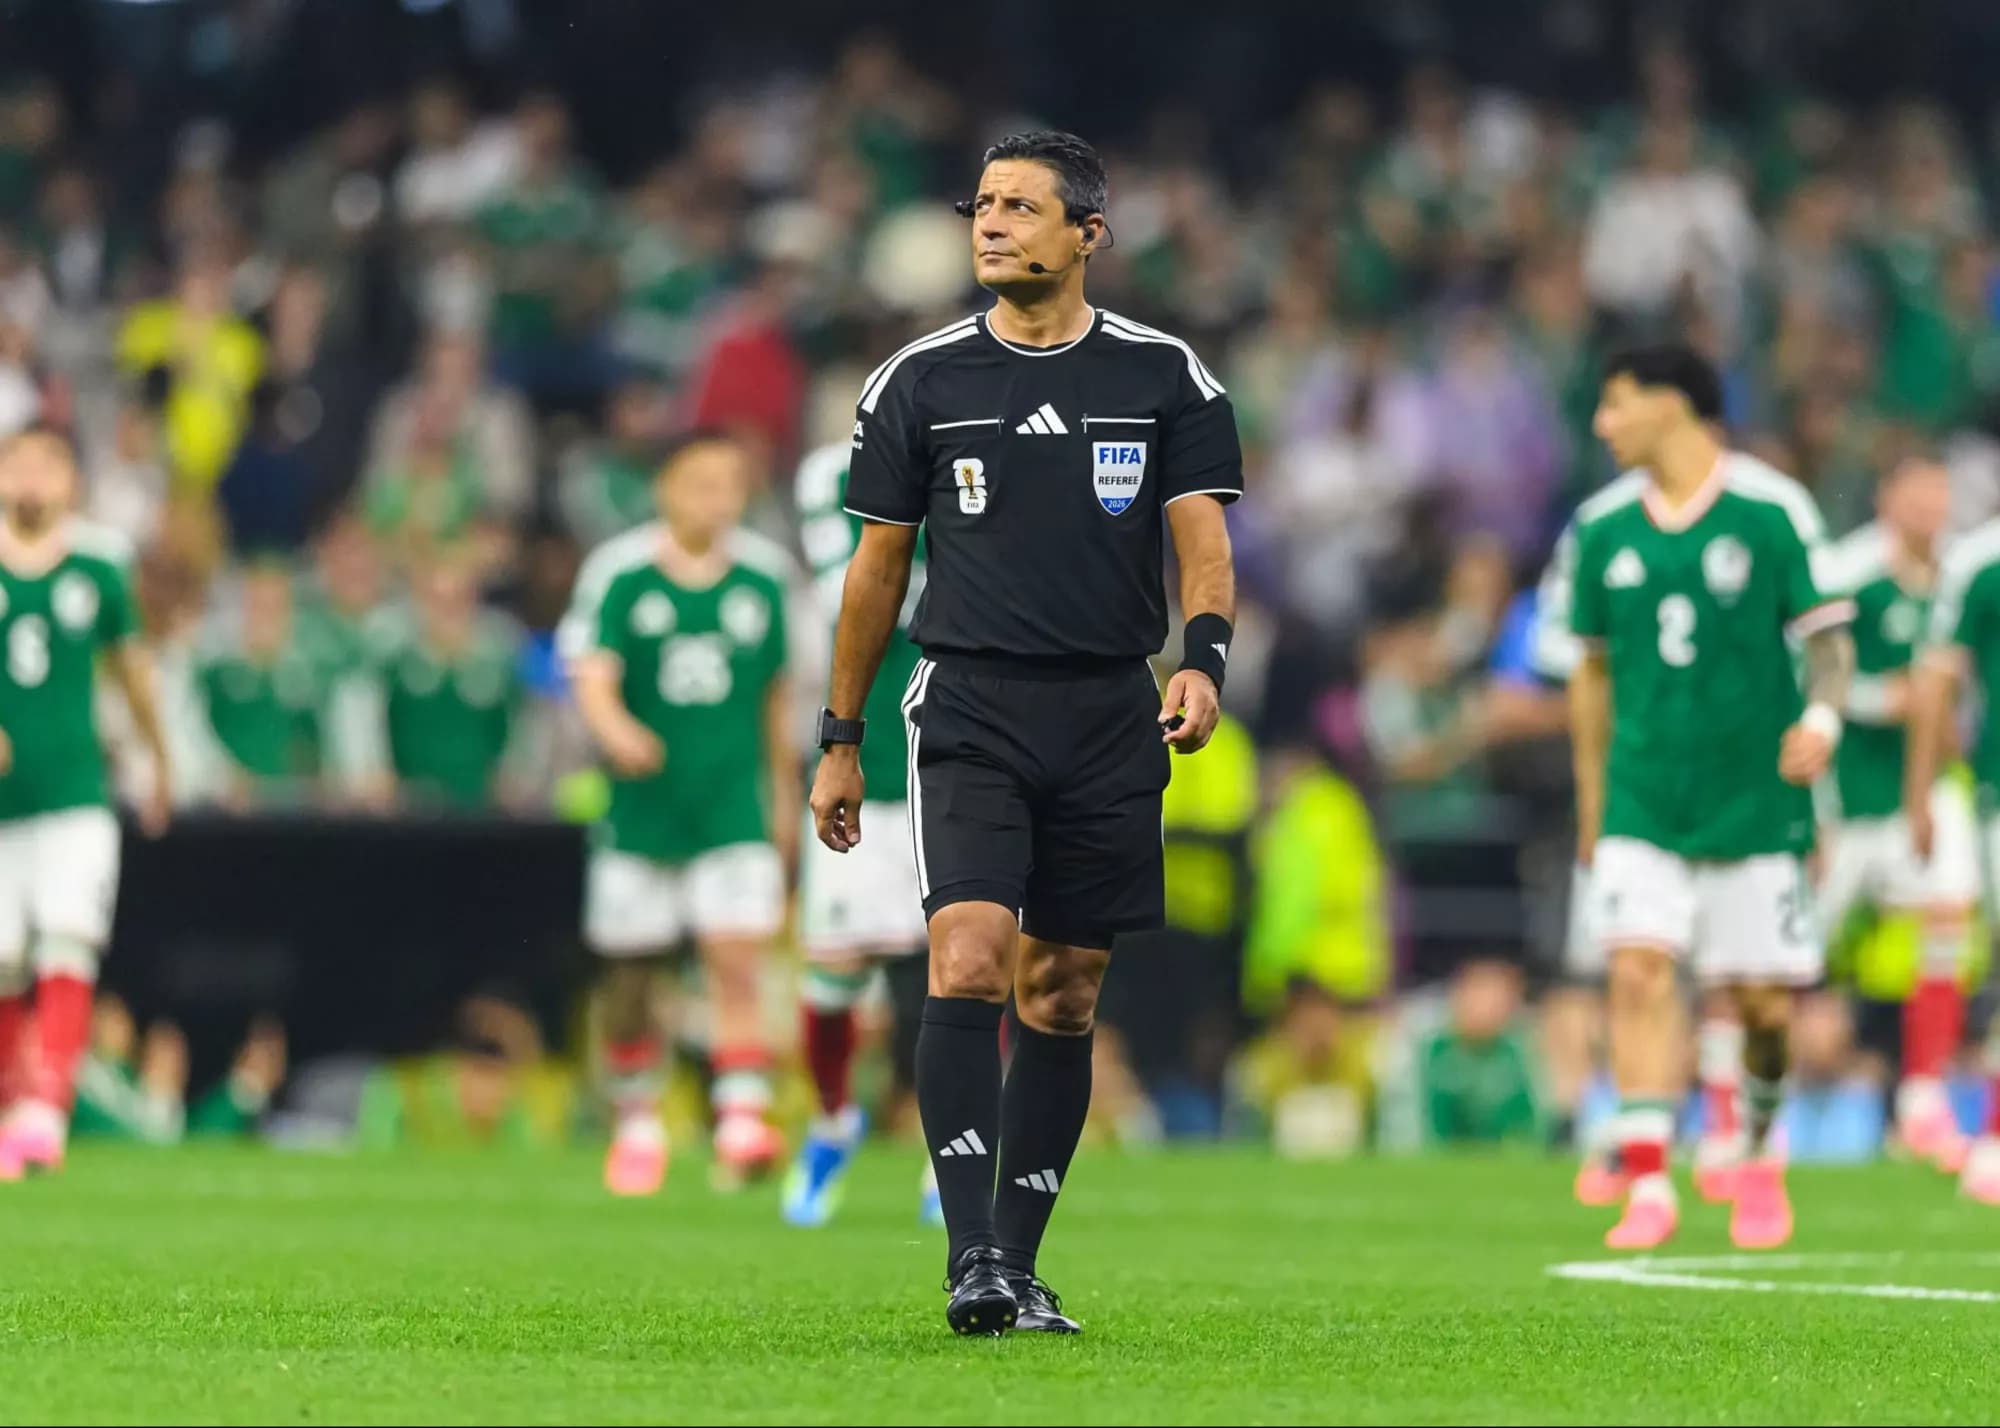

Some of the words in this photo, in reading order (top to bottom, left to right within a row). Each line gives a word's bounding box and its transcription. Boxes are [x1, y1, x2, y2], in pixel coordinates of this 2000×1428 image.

[1099, 447, 1142, 465] FIFA
[1098, 475, 1140, 486] REFEREE
[1108, 499, 1126, 509] 2026
[1656, 593, 1698, 667] 2
